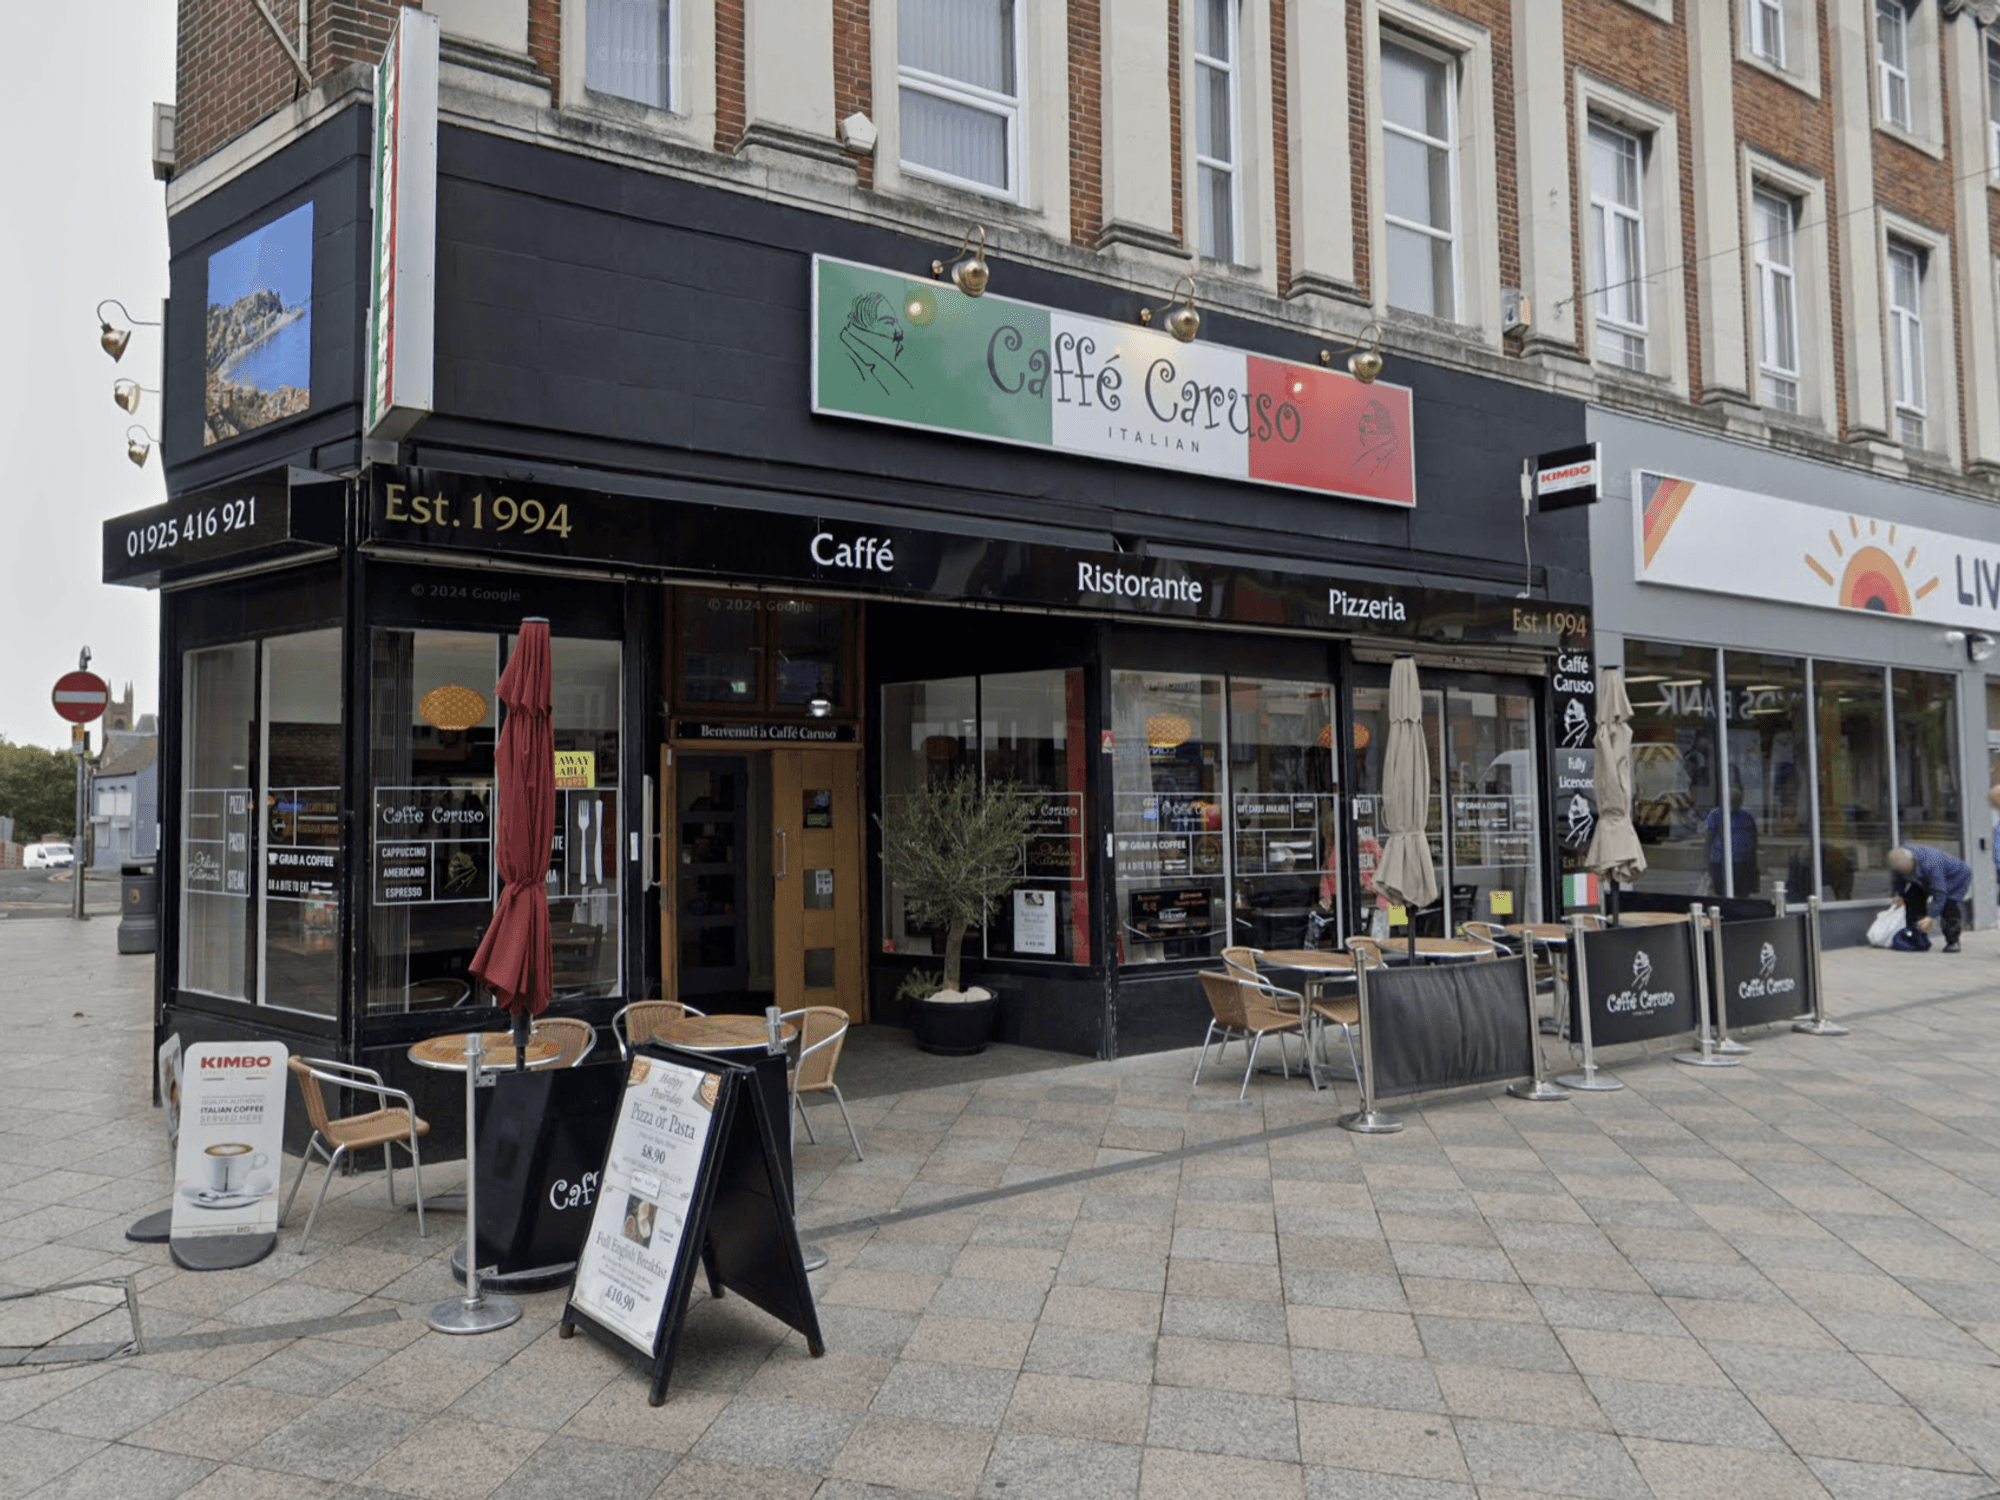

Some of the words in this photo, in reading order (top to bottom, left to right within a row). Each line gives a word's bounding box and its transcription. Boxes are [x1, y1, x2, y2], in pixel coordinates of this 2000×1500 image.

[987, 325, 1122, 411] Caffé
[1145, 359, 1301, 442] Caruso
[1108, 426, 1200, 453] ITALIAN
[1541, 465, 1591, 483] KIMBO
[126, 518, 178, 557] 01925
[183, 507, 217, 541] 416
[222, 496, 256, 532] 921
[811, 532, 894, 572] Caffé
[1078, 562, 1202, 602] Ristorante
[1329, 588, 1407, 621] Pizzeria
[1557, 654, 1588, 673] Caffé
[1553, 674, 1594, 694] Caruso
[701, 724, 758, 738] Benvenuti
[769, 725, 798, 739] Caffé
[800, 727, 837, 740] Caruso
[1568, 757, 1586, 773] Fully
[229, 795, 246, 815] PIZZA
[431, 806, 485, 824] Caruso
[1040, 803, 1078, 817] Caruso
[228, 832, 246, 852] PASTA
[382, 847, 426, 857] CAPPUCCINO
[1130, 841, 1151, 850] GRAB
[1158, 840, 1187, 849] COFFEE
[279, 854, 298, 866] GRAB
[299, 856, 305, 866] A
[306, 856, 334, 868] COFFEE
[227, 870, 246, 890] STEAK
[383, 867, 425, 878] AMERICANO
[385, 887, 422, 898] ESPRESSO
[1739, 978, 1765, 999] Caffé
[1766, 977, 1795, 995] Caruso
[1607, 990, 1637, 1013] Caffé
[1639, 990, 1675, 1009] Caruso
[201, 1056, 272, 1069] KIMBO
[200, 1105, 232, 1114] ITALIAN
[233, 1105, 264, 1113] COFFEE
[200, 1114, 237, 1123] SERVED
[239, 1113, 264, 1122] HERE
[630, 1101, 653, 1126] Pizza
[655, 1114, 668, 1130] or
[668, 1114, 696, 1141] Pasta
[641, 1144, 666, 1165] £8.90
[596, 1231, 610, 1248] Full
[611, 1236, 637, 1261] English
[636, 1250, 668, 1280] Breakfast
[605, 1285, 635, 1312] £10.90
